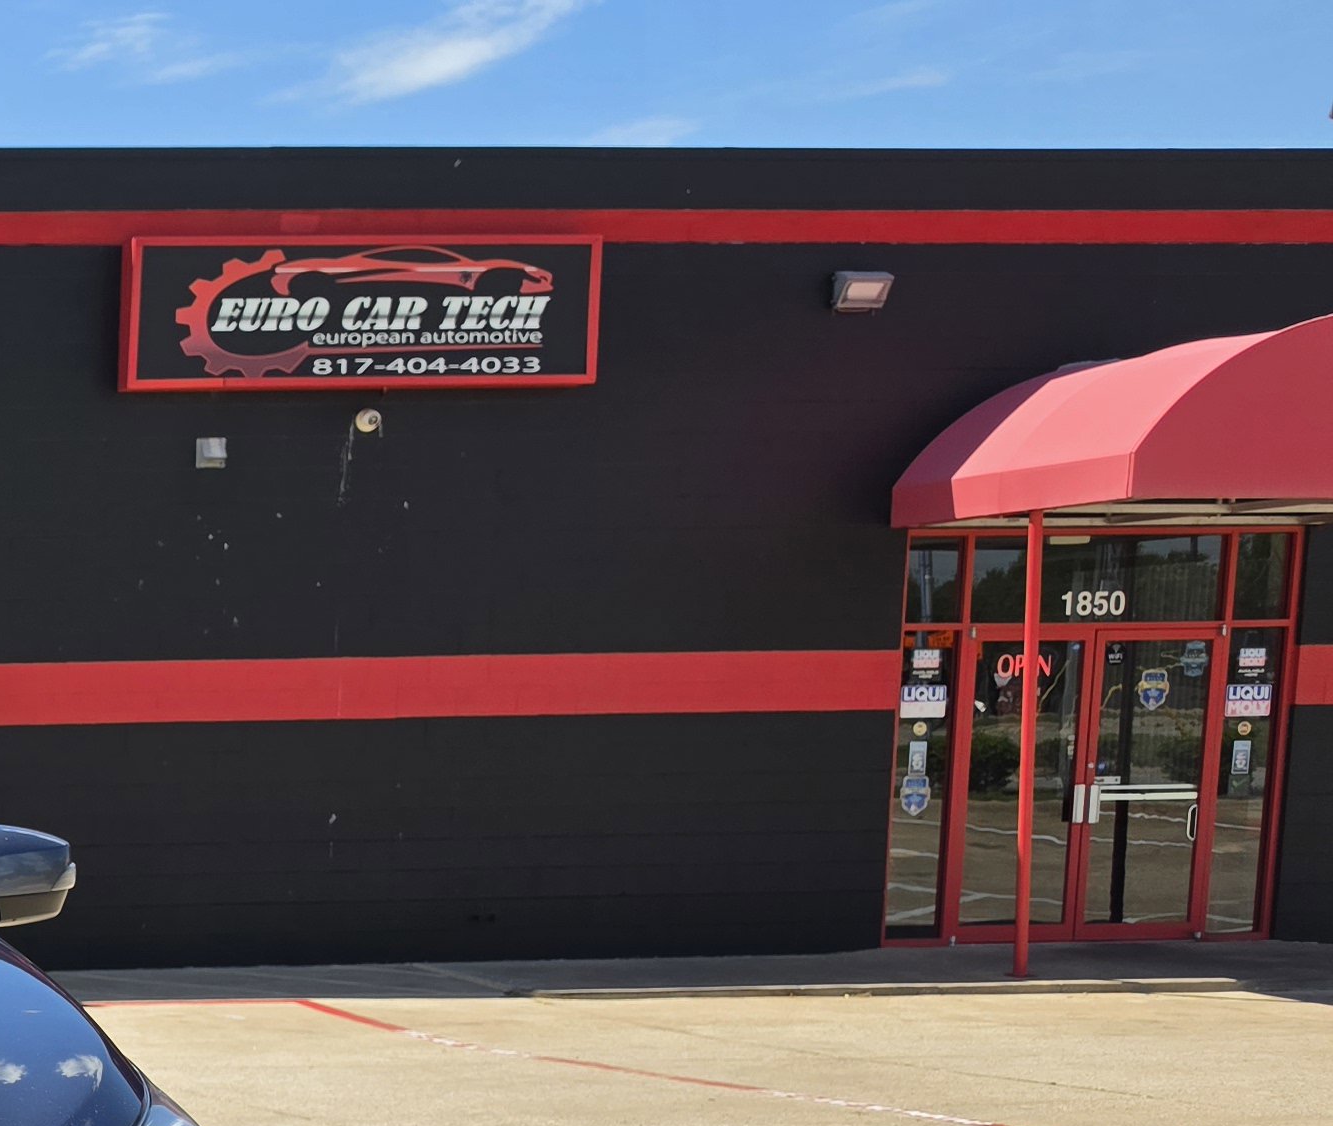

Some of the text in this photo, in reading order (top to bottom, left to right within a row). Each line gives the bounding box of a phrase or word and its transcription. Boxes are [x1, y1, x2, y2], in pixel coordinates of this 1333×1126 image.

[211, 296, 551, 332] EURO CAR TECH
[312, 328, 543, 349] european automotive
[311, 356, 541, 375] 817-404-4033
[1061, 590, 1126, 616] 1850
[997, 653, 1052, 678] OPN
[904, 686, 946, 701] LIQUI
[1228, 685, 1270, 700] LIQUI
[1226, 701, 1269, 715] MOLY
